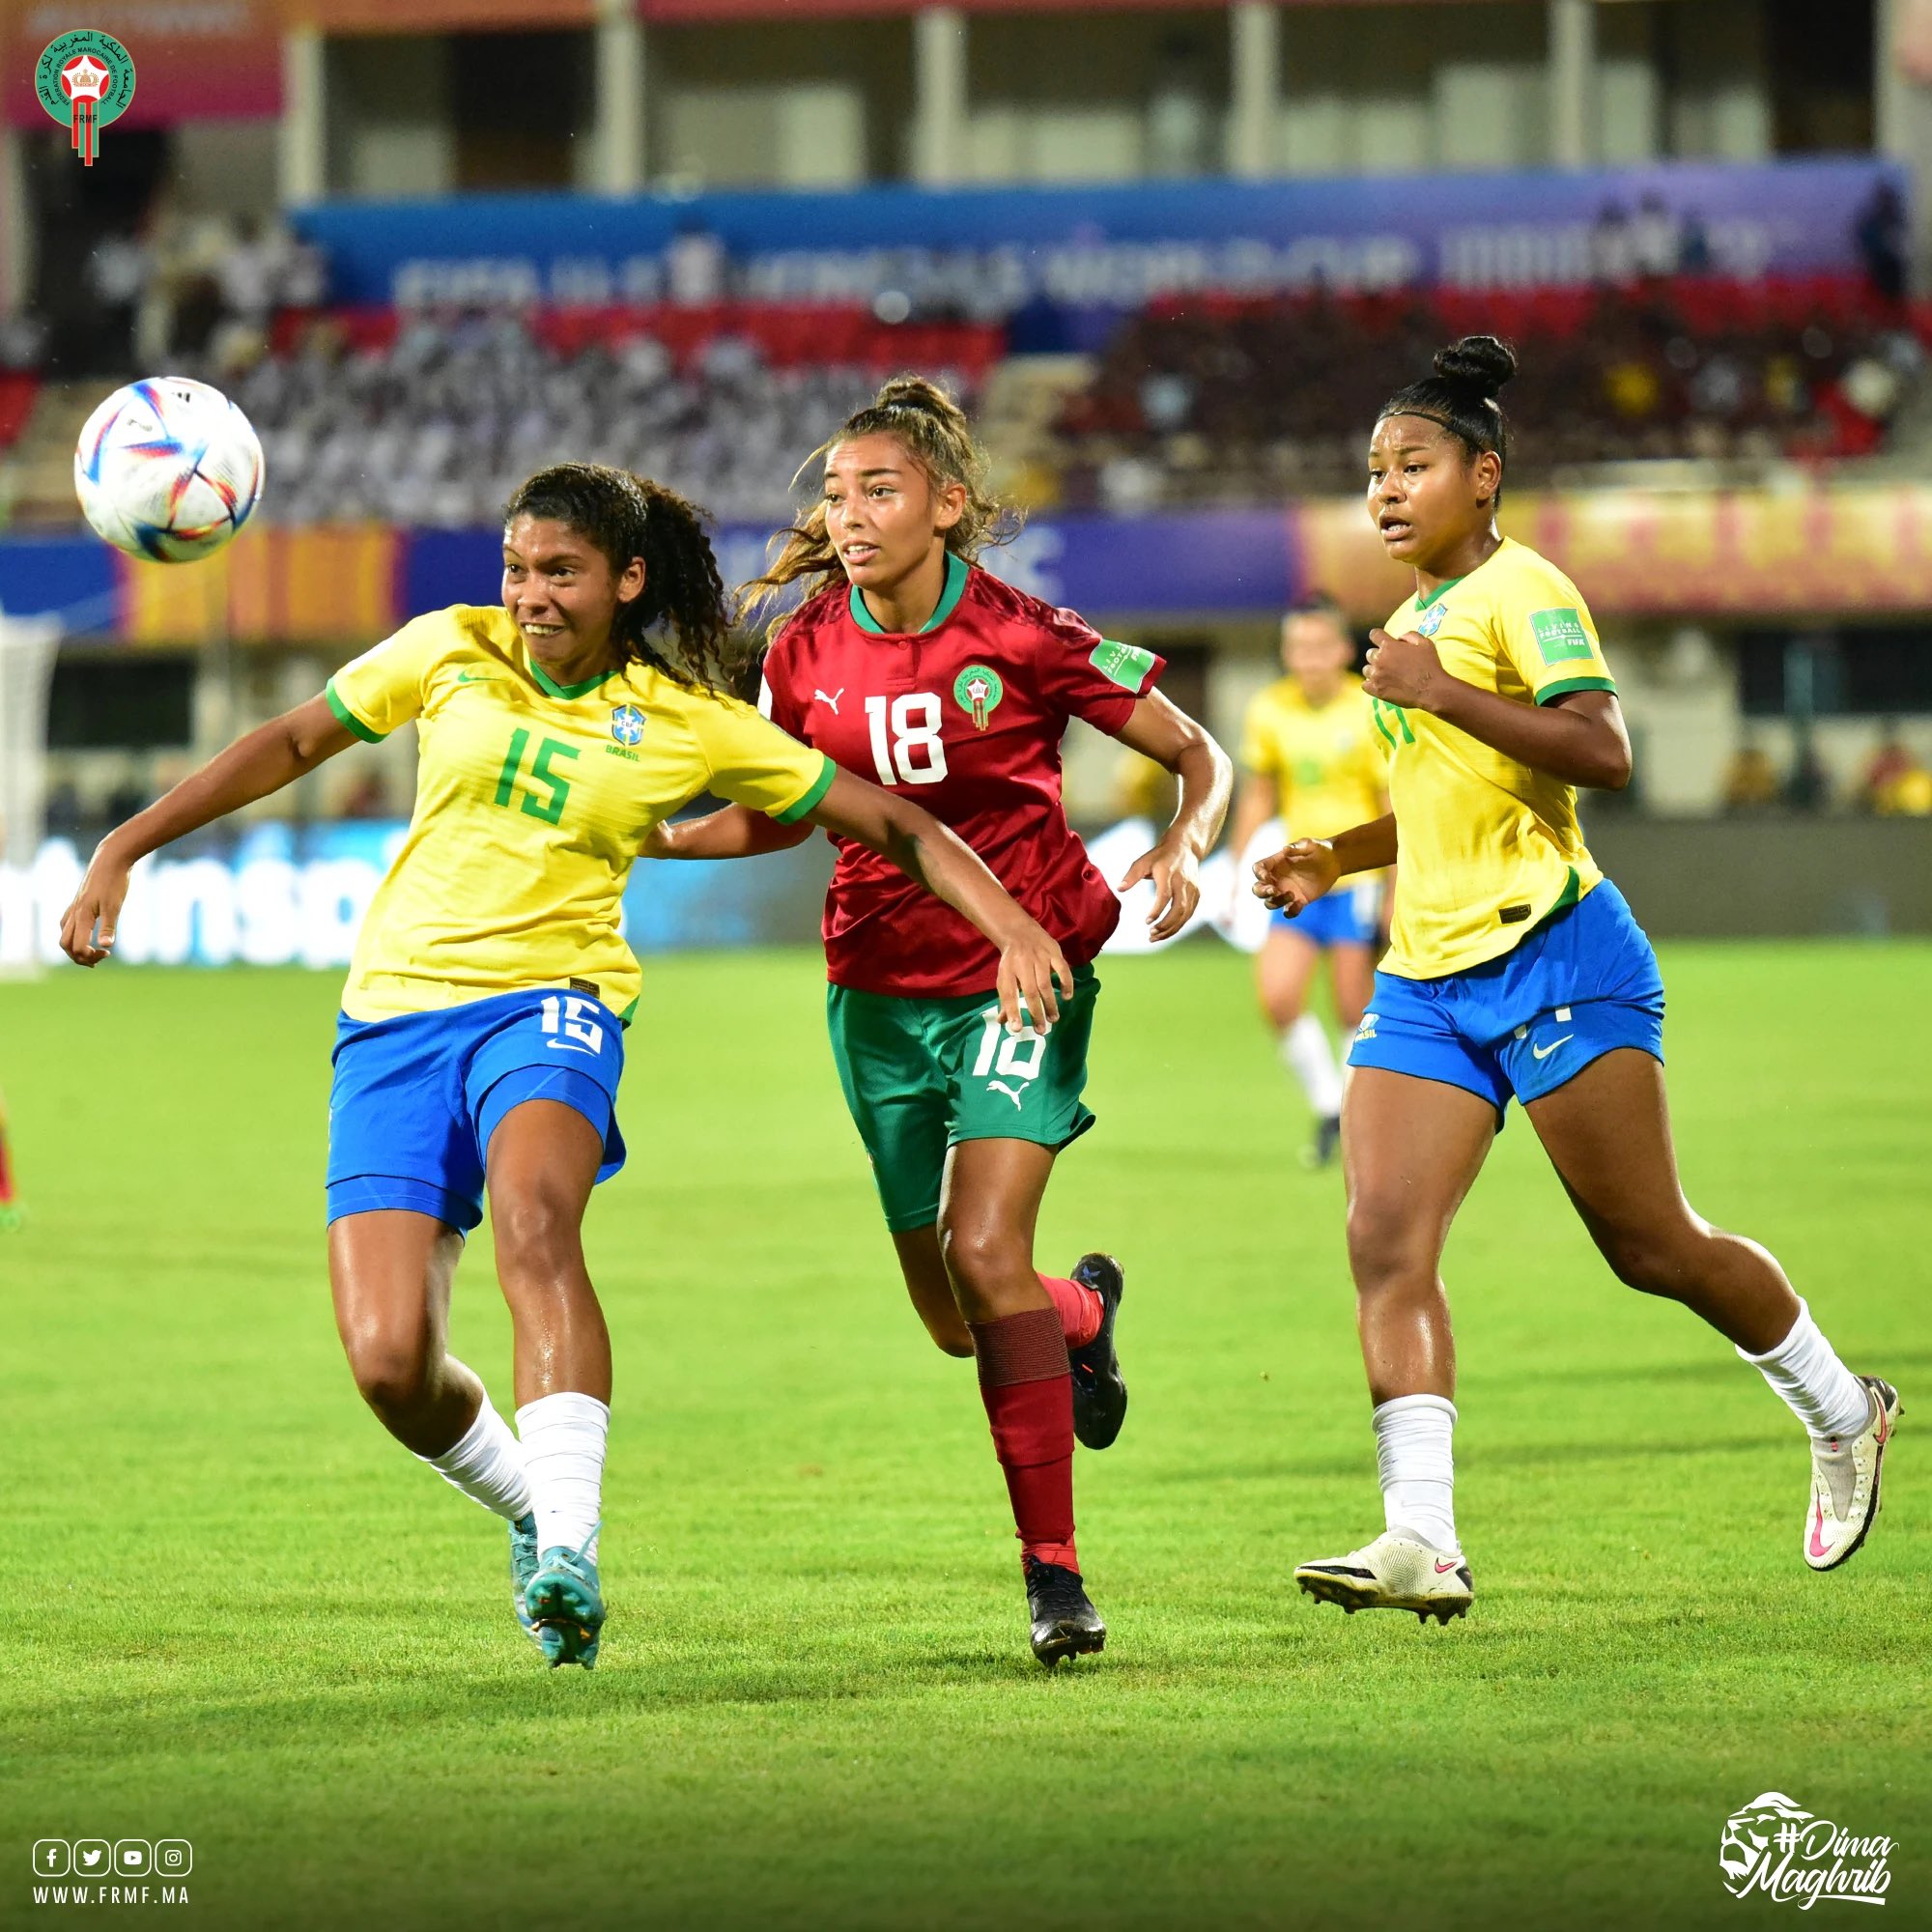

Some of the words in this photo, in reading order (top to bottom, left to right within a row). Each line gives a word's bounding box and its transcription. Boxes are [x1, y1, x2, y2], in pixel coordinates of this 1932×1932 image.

[494, 727, 582, 826] 15
[606, 745, 640, 762] BRASIL
[866, 692, 949, 785] 18
[541, 996, 603, 1055] 15
[972, 997, 1053, 1080] 18
